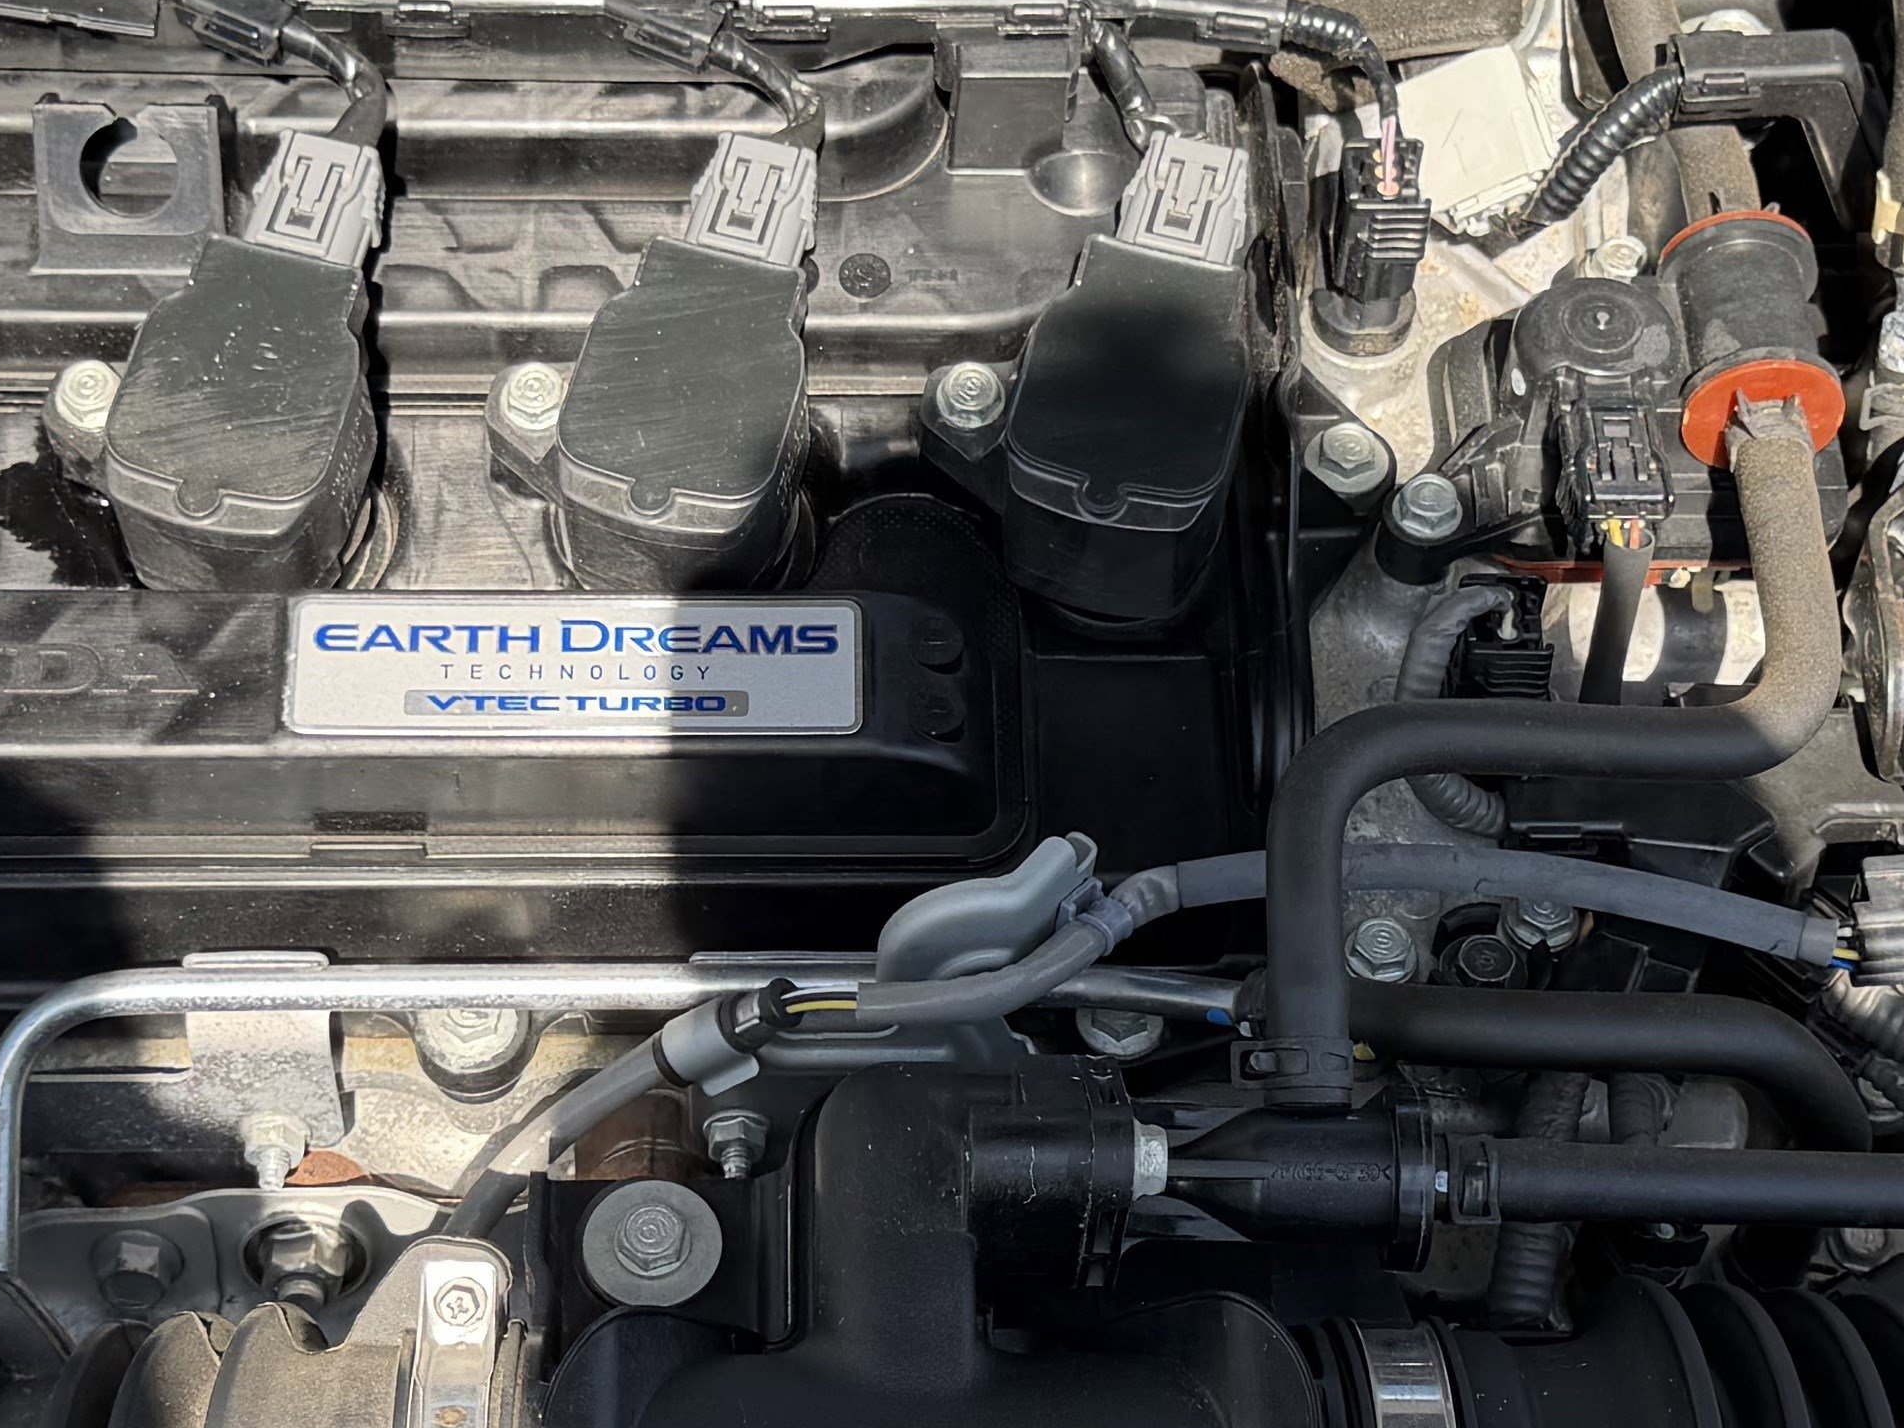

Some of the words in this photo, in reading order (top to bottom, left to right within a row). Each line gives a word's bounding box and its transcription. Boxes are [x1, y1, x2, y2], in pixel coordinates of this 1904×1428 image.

[313, 622, 539, 653] EARTH
[561, 619, 839, 654] DREAMS
[441, 663, 712, 680] TECHNOLOGY
